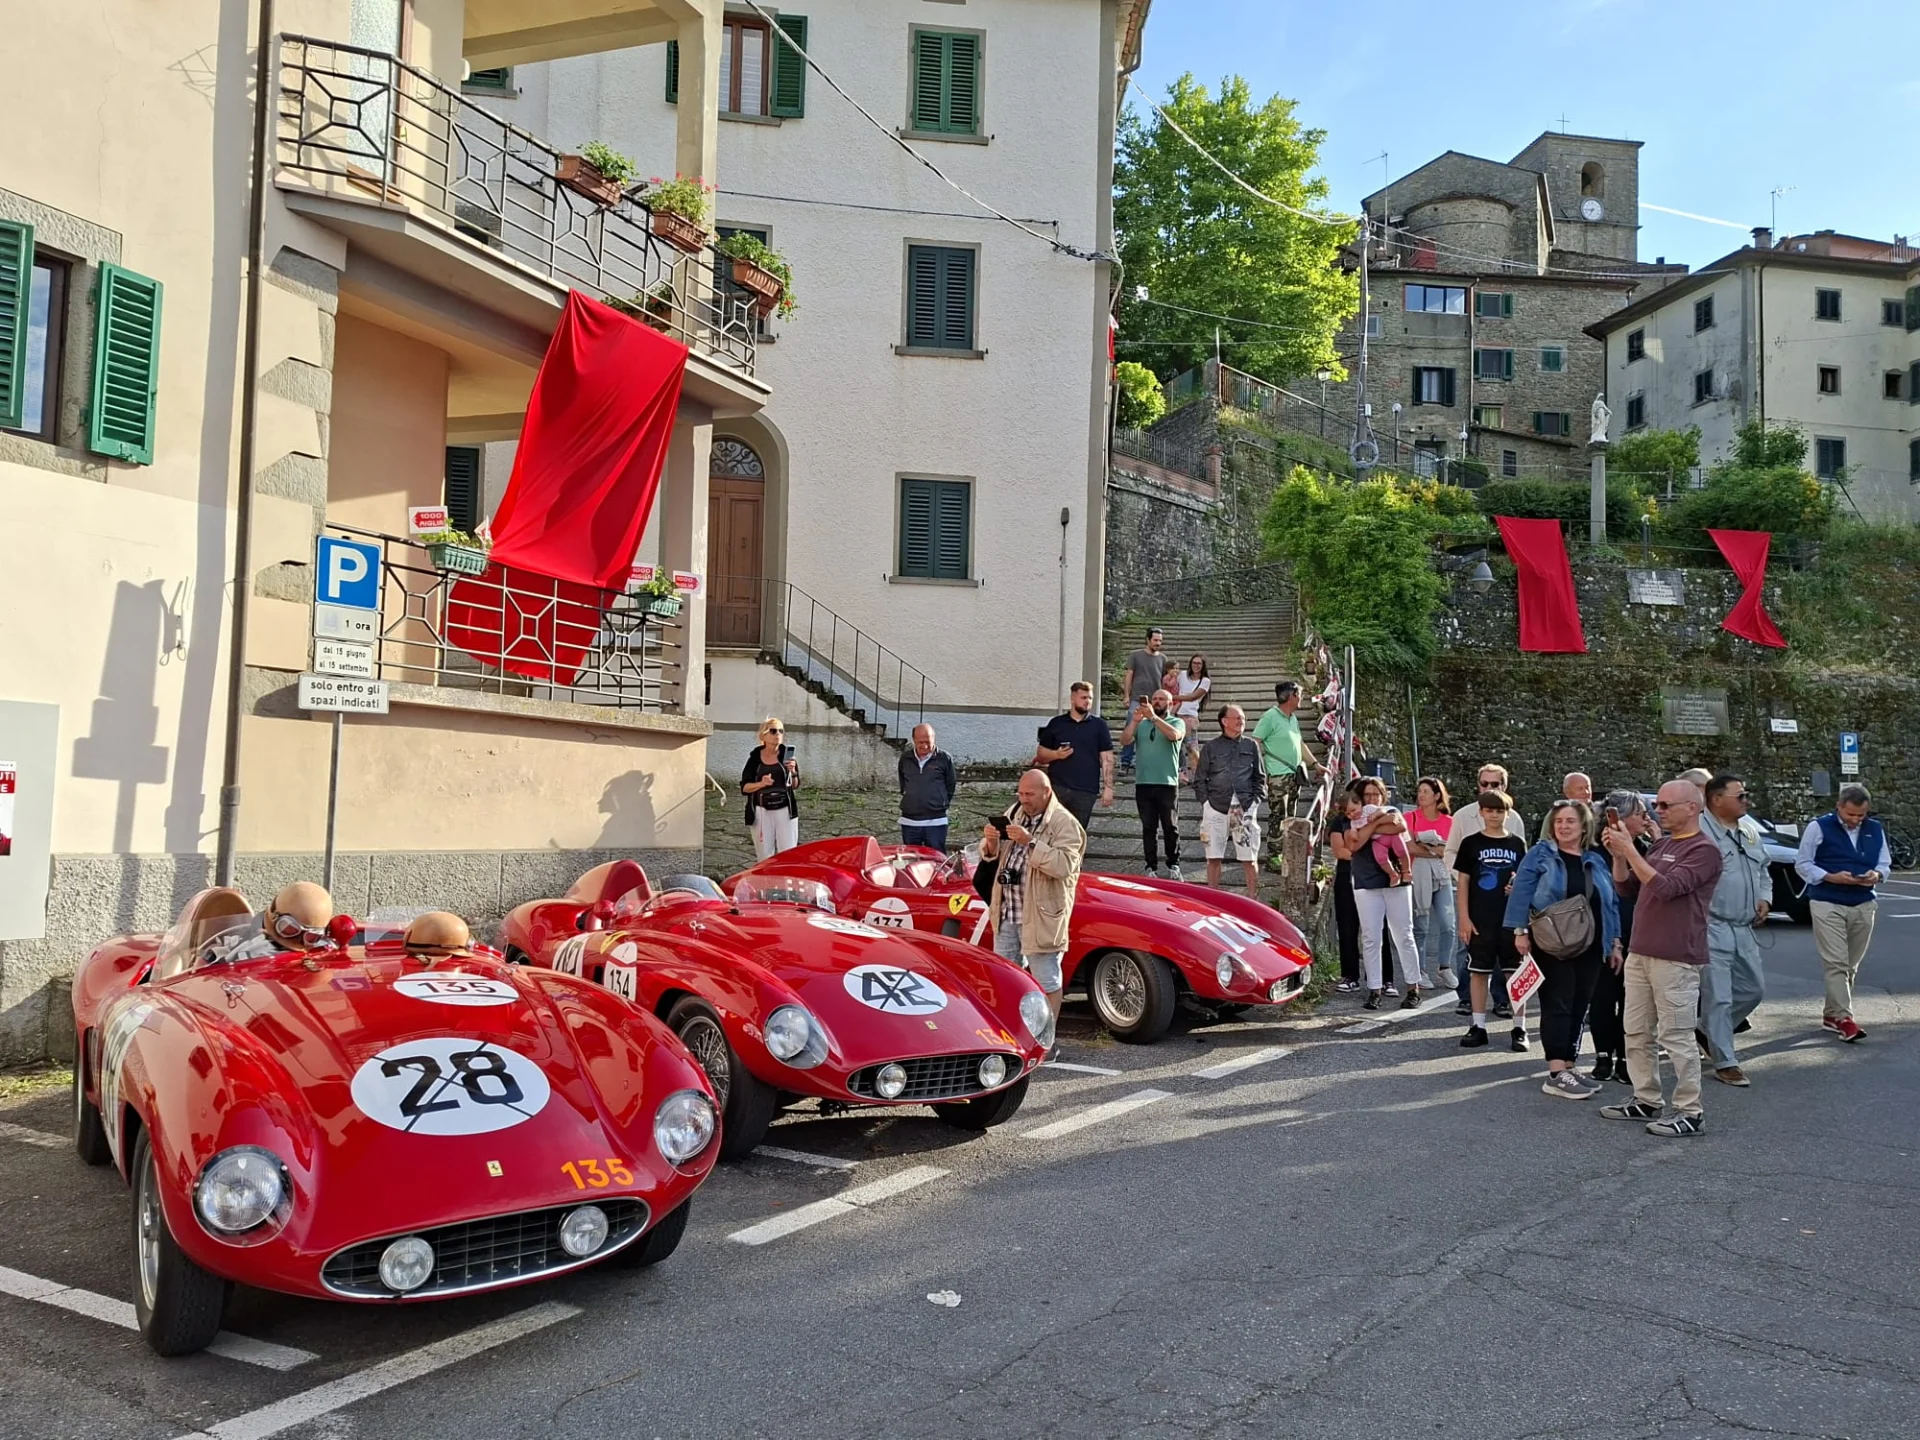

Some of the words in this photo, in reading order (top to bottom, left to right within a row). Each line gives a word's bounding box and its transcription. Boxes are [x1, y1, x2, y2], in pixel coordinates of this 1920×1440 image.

[328, 545, 368, 598] P
[355, 621, 371, 631] ora
[323, 646, 333, 654] dal
[336, 647, 343, 656] 15
[346, 649, 366, 659] giugno
[319, 660, 325, 668] al
[328, 660, 336, 669] 15
[339, 663, 369, 673] settembre
[310, 680, 333, 691] solo
[336, 682, 364, 693] entro
[367, 685, 380, 695] gli
[310, 695, 337, 707] spazi
[341, 696, 380, 708] indicati
[1843, 735, 1854, 751] P
[1478, 848, 1516, 861] JORDAN
[417, 980, 497, 995] 135
[610, 968, 630, 999] 134
[1517, 972, 1538, 997] 1000
[975, 1028, 1017, 1047] 134
[380, 1050, 525, 1118] 28
[560, 1158, 635, 1190] 135
